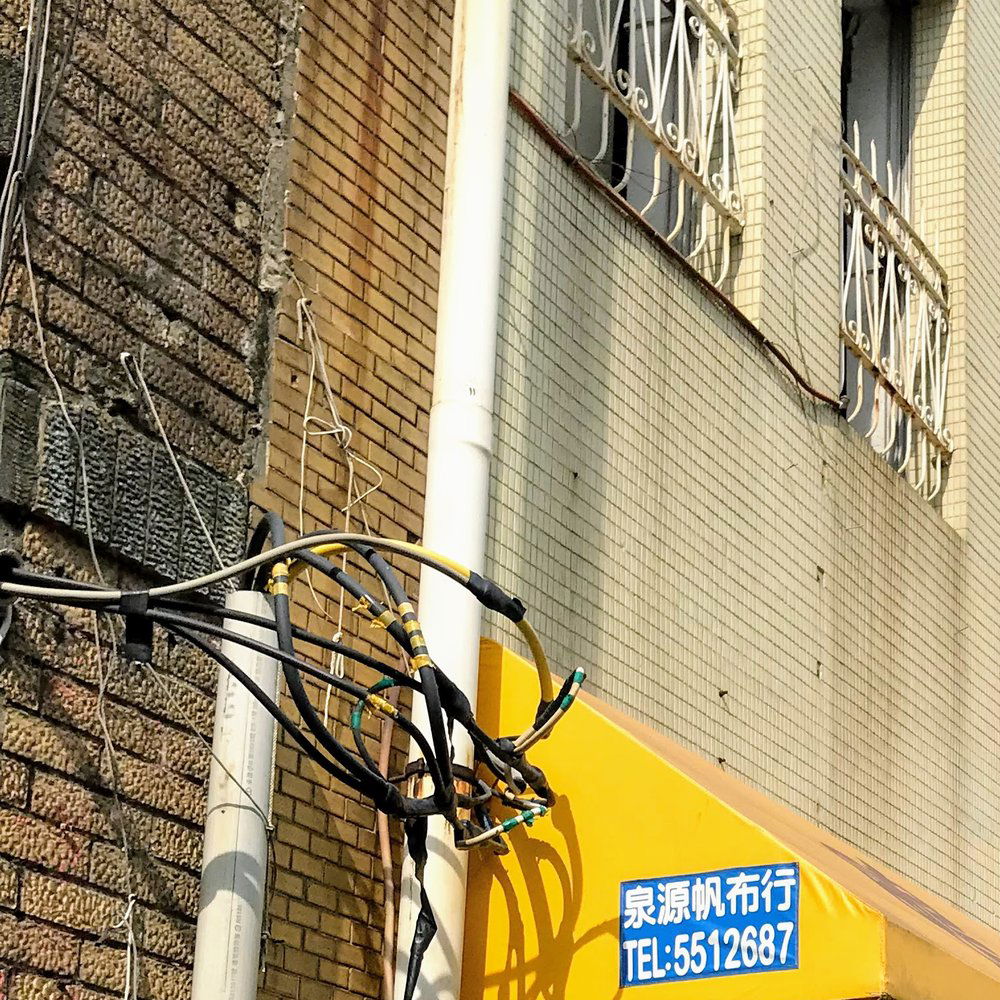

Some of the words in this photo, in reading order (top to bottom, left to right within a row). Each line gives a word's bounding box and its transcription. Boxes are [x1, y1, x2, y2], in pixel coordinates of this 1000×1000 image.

[623, 868, 797, 930] 泉源帆布行
[622, 921, 795, 983] TEL:5512687
